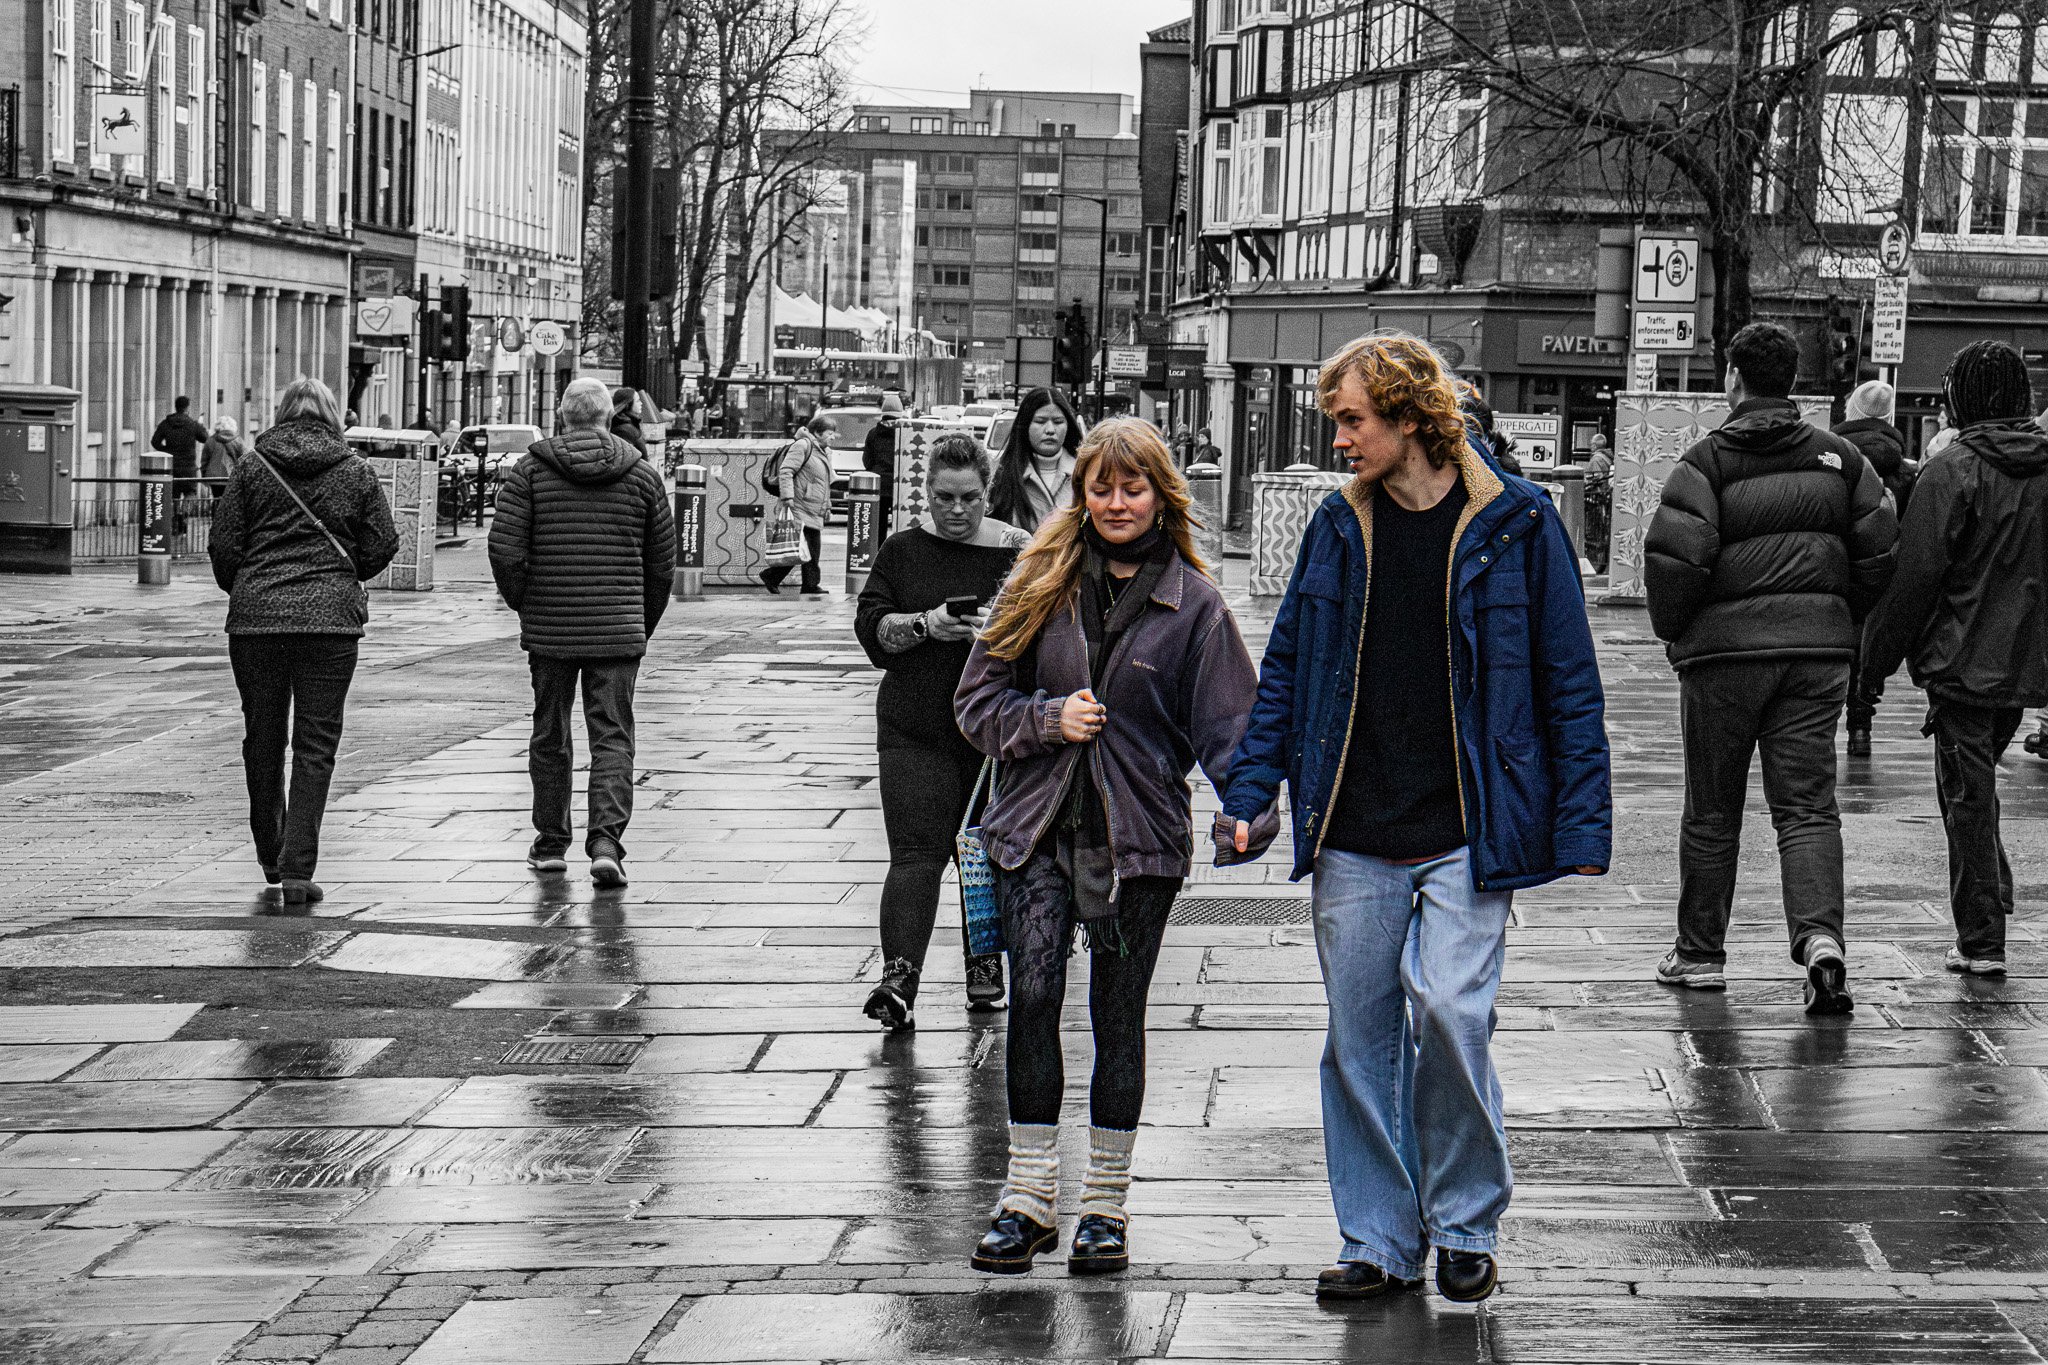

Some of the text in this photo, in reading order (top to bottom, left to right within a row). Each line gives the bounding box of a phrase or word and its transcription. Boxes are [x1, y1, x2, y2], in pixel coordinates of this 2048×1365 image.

[1647, 316, 1666, 325] Traffic
[1637, 326, 1675, 335] enforcement
[536, 332, 557, 340] Cake
[1882, 351, 1901, 361] loading
[1168, 369, 1186, 377] Local
[1493, 421, 1554, 432] OPPERGATE
[153, 483, 164, 520] Enjoy York
[690, 495, 700, 553] Choose Respect
[862, 502, 871, 540] Enjoy York
[681, 509, 692, 551] Not Regrets
